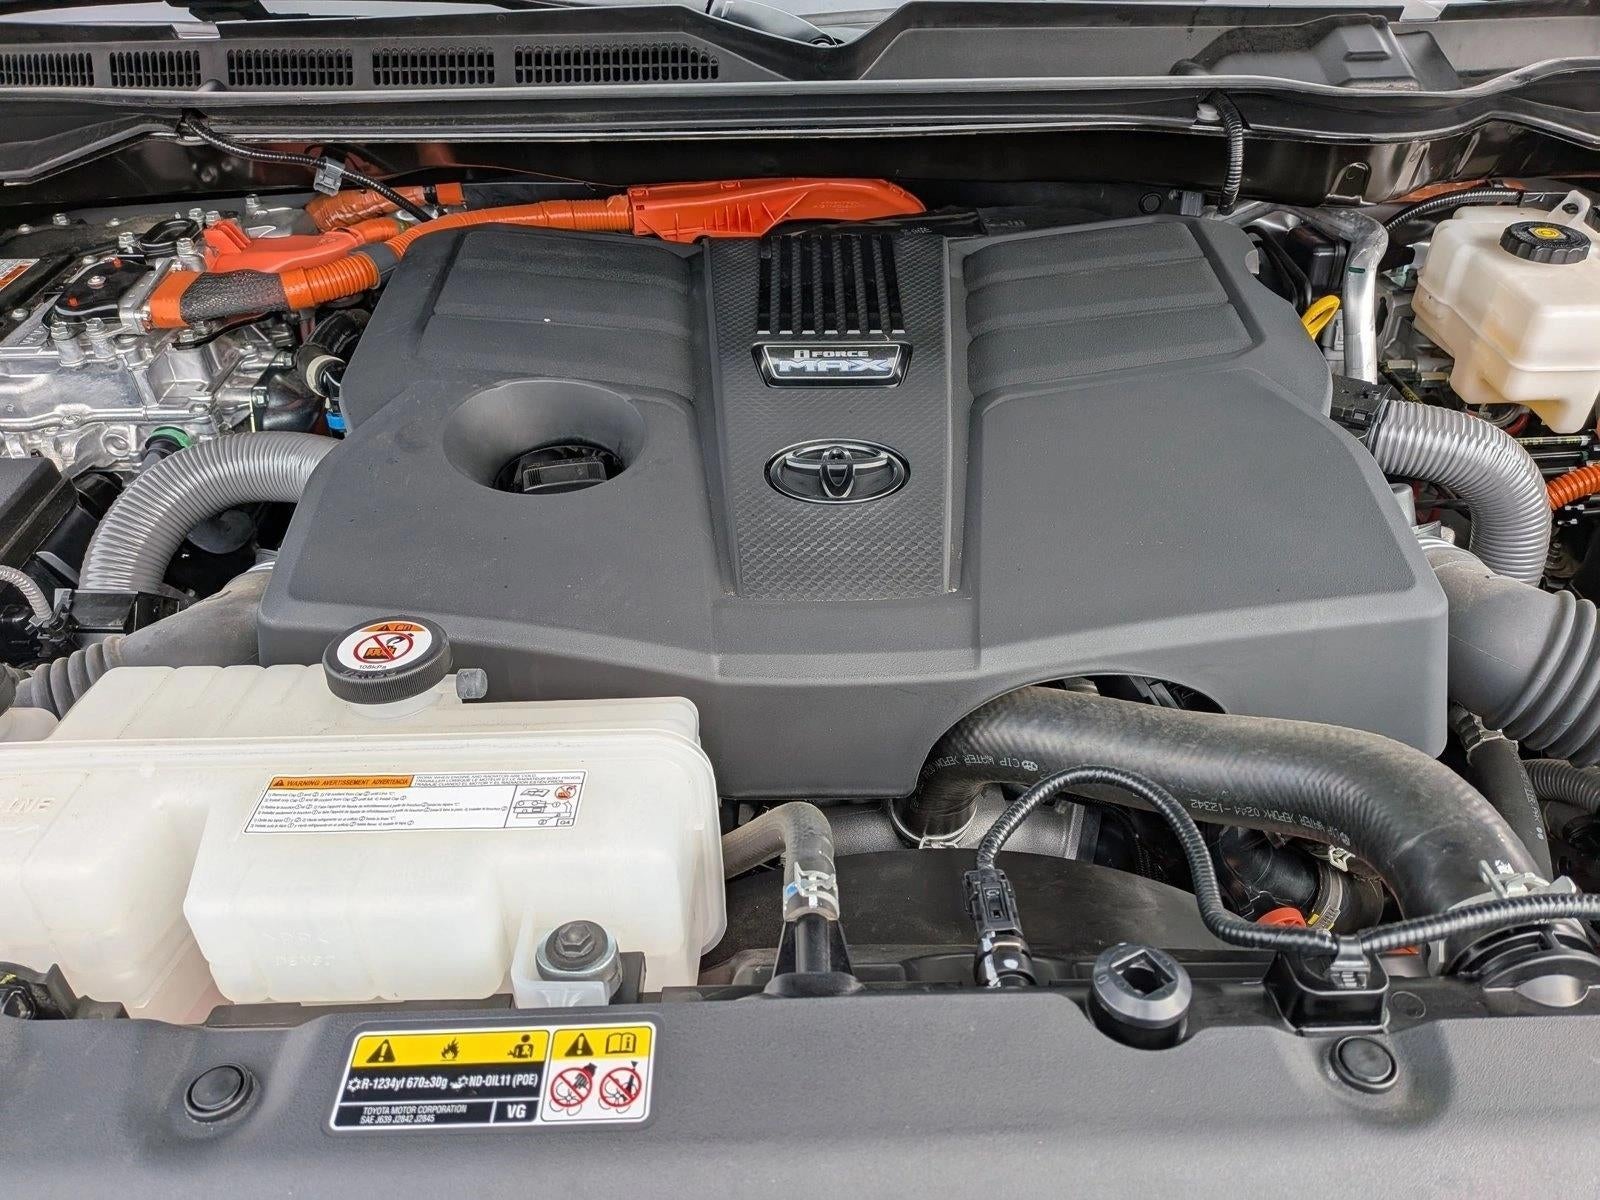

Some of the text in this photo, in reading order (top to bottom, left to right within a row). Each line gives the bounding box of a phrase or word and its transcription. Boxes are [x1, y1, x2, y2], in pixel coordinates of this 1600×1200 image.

[778, 359, 889, 372] MAX
[287, 779, 320, 787] WARNING
[371, 778, 408, 786] ADVERTENCIA
[360, 1072, 539, 1091] R-1234yf 670±30g ND-OIL11 (POE)
[363, 1103, 527, 1119] TOYOTA MOTOR CORPORATION VG
[359, 1114, 436, 1124] SAE J639 J2842 J2845
